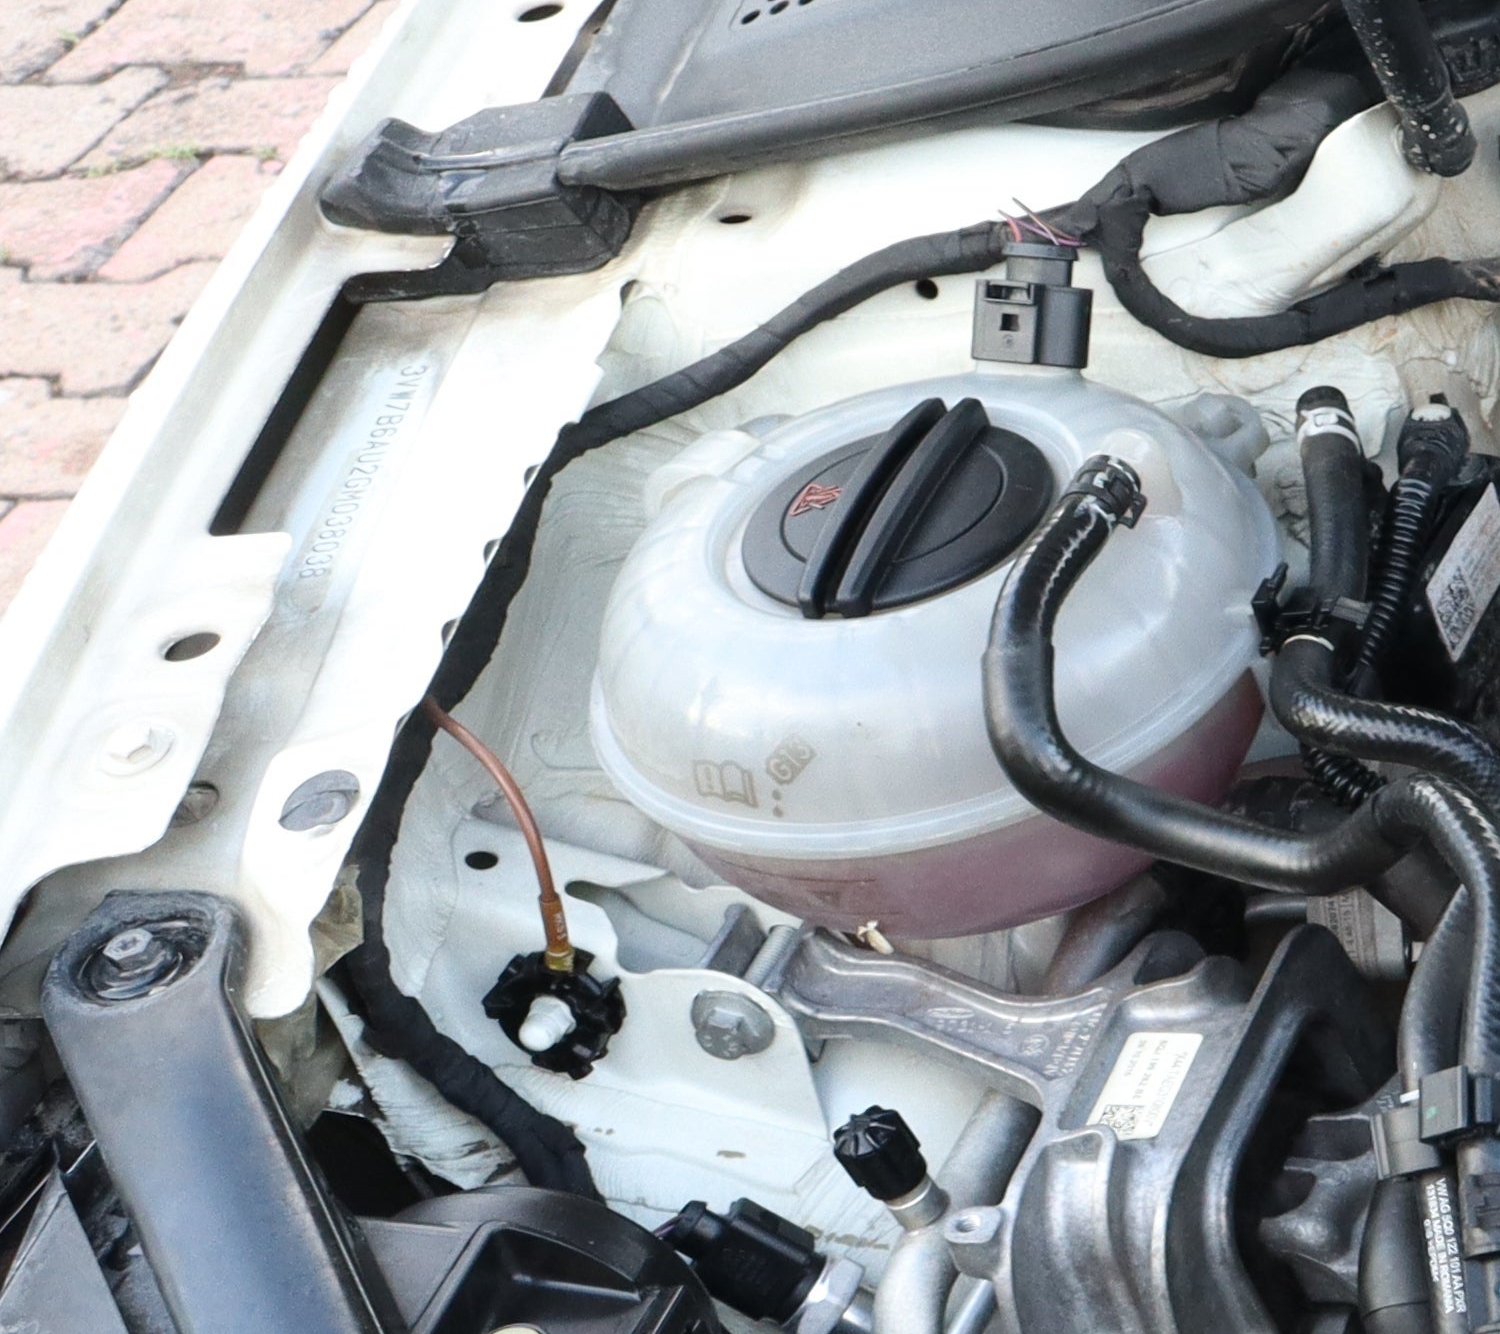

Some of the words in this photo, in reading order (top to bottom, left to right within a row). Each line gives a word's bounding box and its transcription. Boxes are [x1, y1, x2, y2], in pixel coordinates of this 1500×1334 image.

[1436, 1178, 1448, 1197] VW
[1439, 1197, 1450, 1213] AG
[1432, 1220, 1444, 1250] MADE
[1438, 1253, 1448, 1263] IN
[1440, 1266, 1454, 1313] ROMANIA
